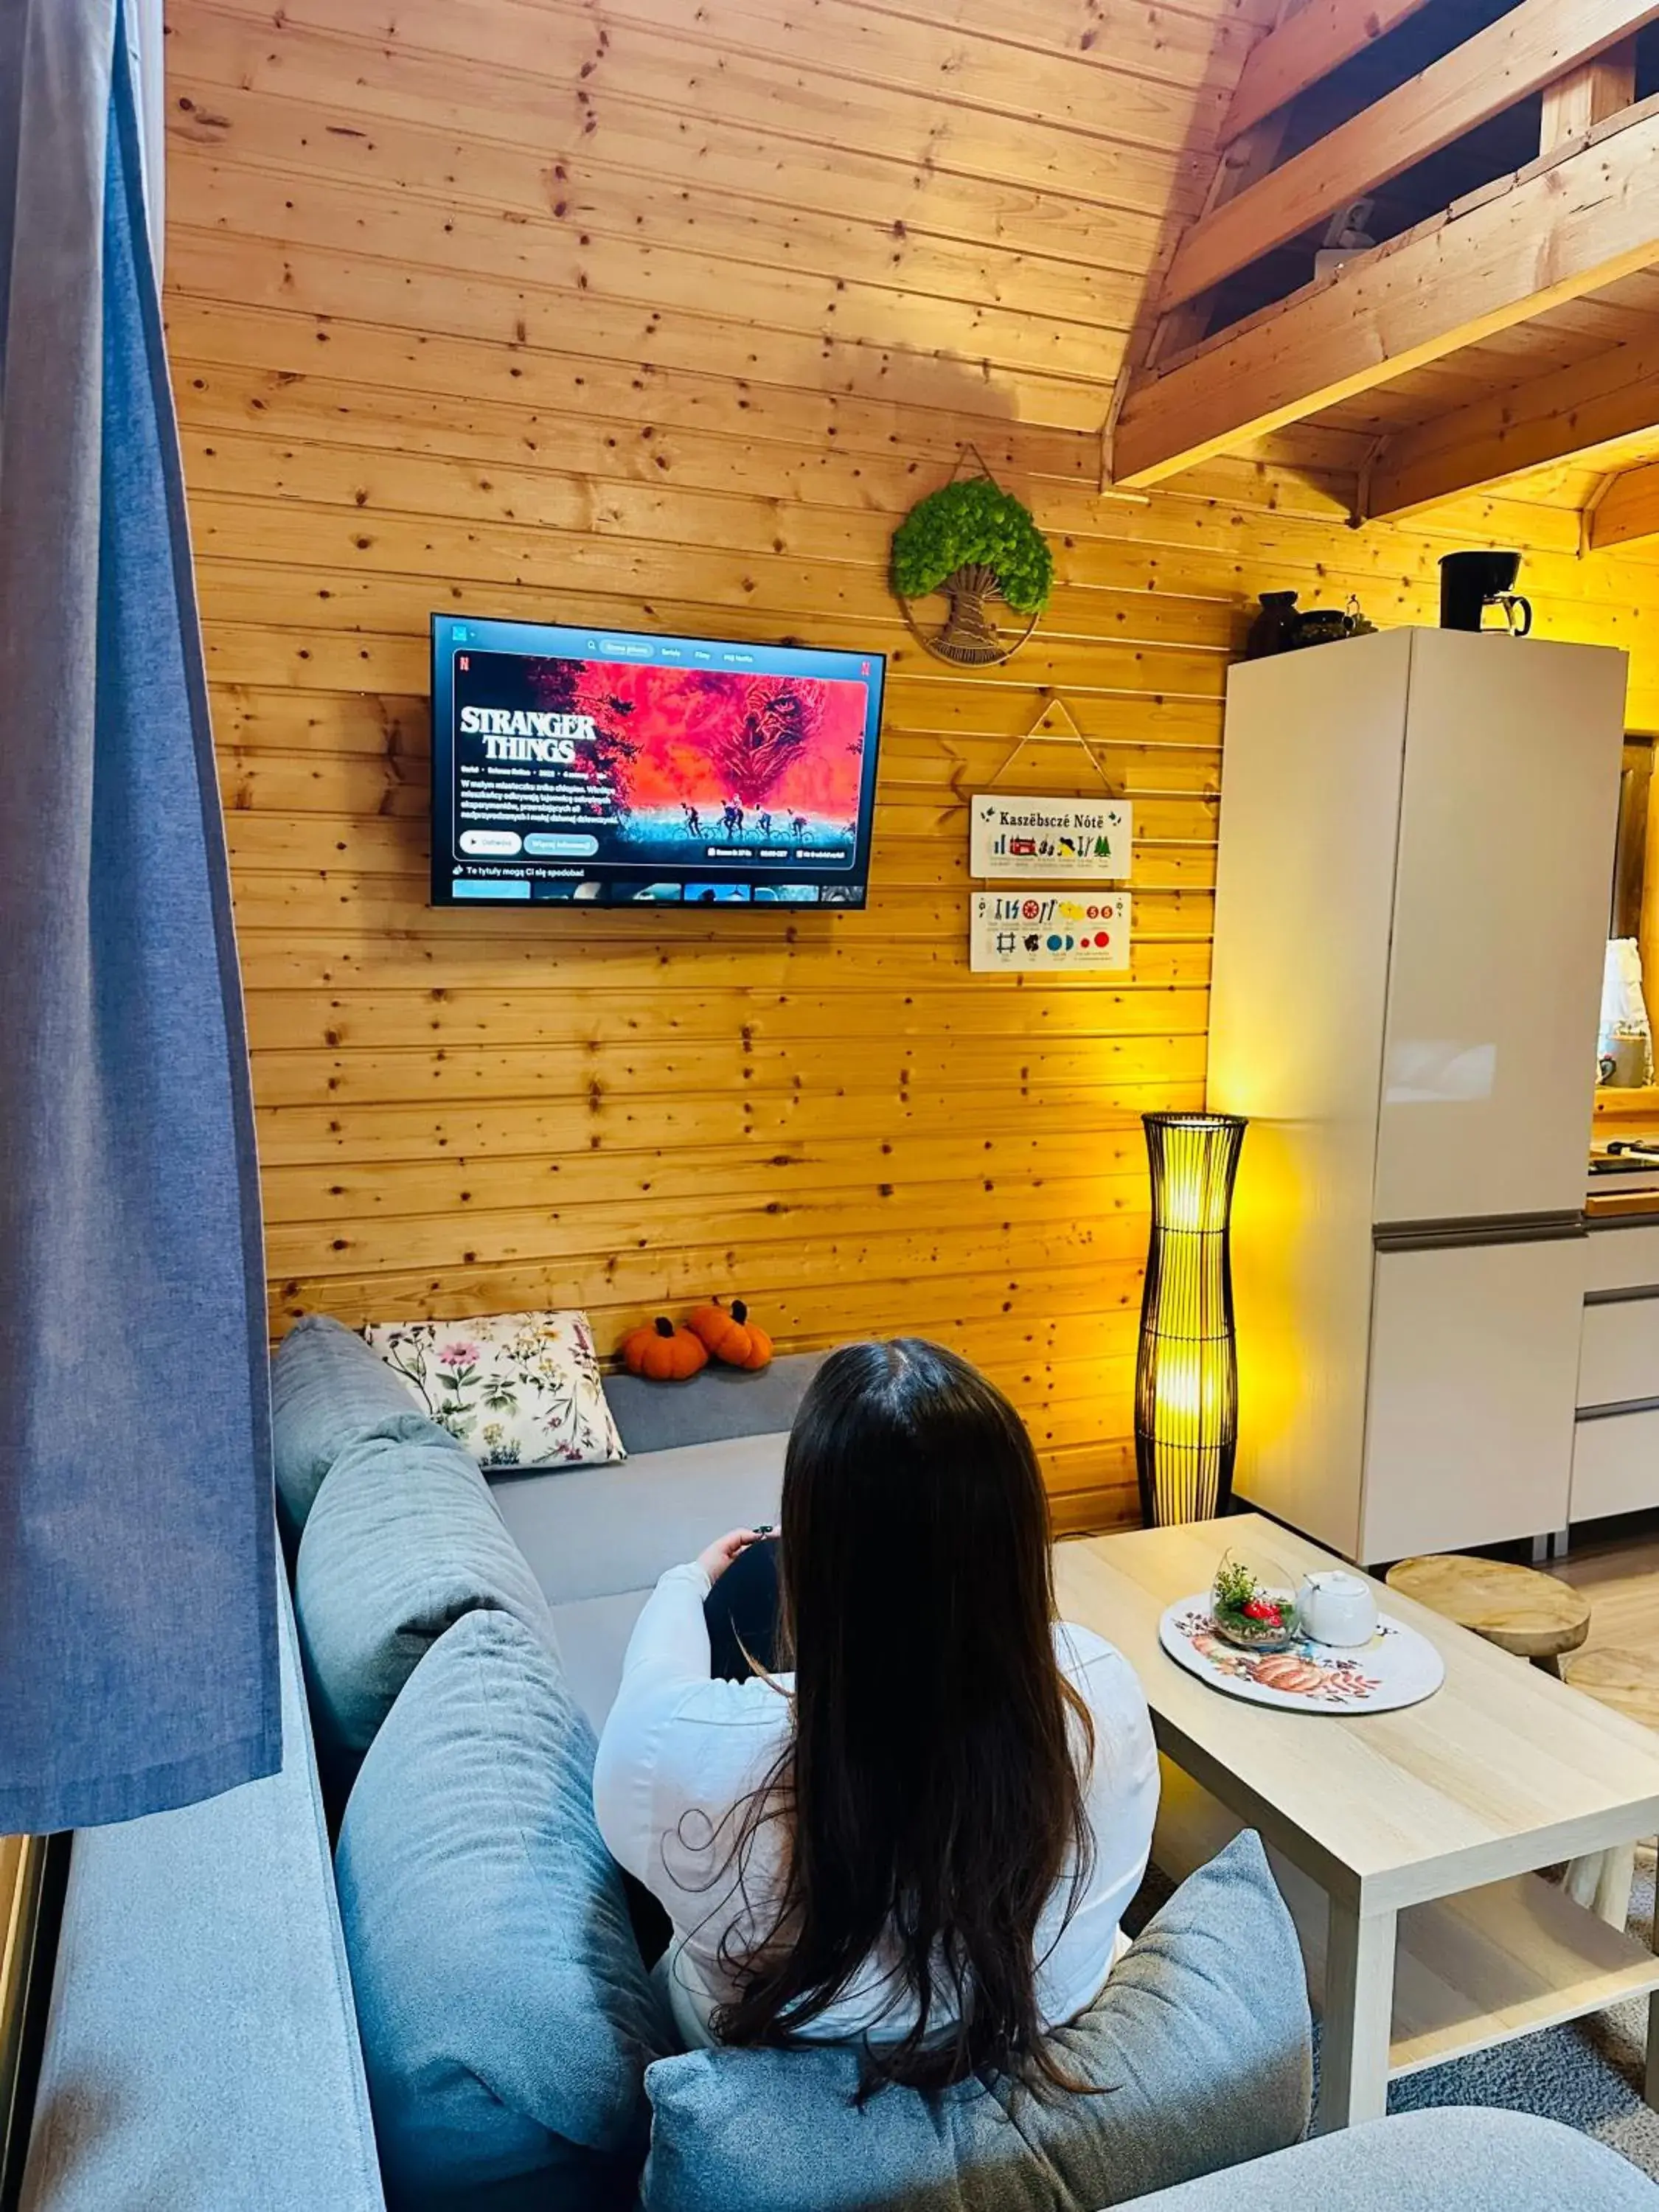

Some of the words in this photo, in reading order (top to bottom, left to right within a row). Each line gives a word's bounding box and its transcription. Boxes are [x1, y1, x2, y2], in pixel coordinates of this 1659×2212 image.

[460, 706, 597, 740] STRANGER
[481, 734, 577, 764] THINGS
[1000, 812, 1070, 827] Kaszëbsczé
[1074, 814, 1104, 828] Nótë
[466, 866, 477, 874] Te
[502, 869, 524, 877] mogą
[526, 867, 535, 876] Ci
